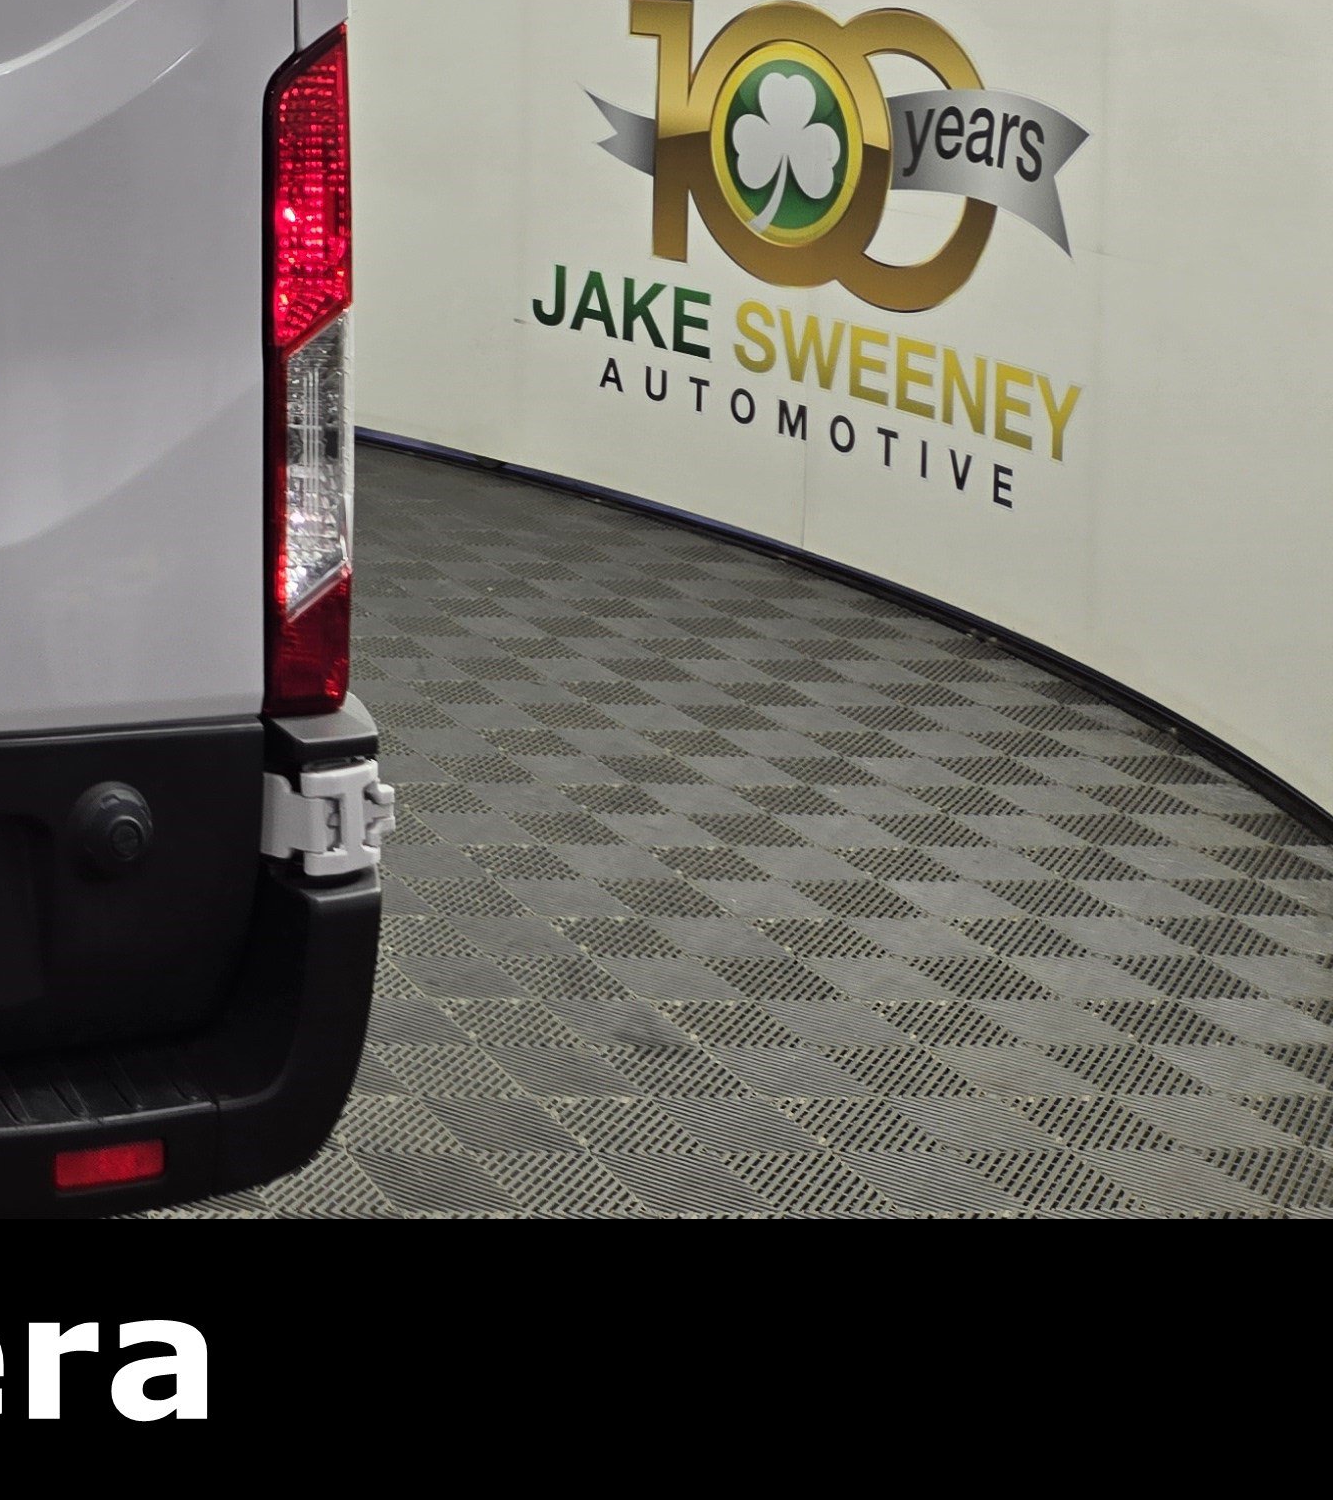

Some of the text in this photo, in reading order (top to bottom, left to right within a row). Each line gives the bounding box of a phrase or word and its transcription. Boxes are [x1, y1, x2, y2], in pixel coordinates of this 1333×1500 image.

[902, 105, 1045, 182] years
[532, 264, 1082, 462] JAKE SWEENEY
[599, 357, 1014, 510] AUTOMOTIVE
